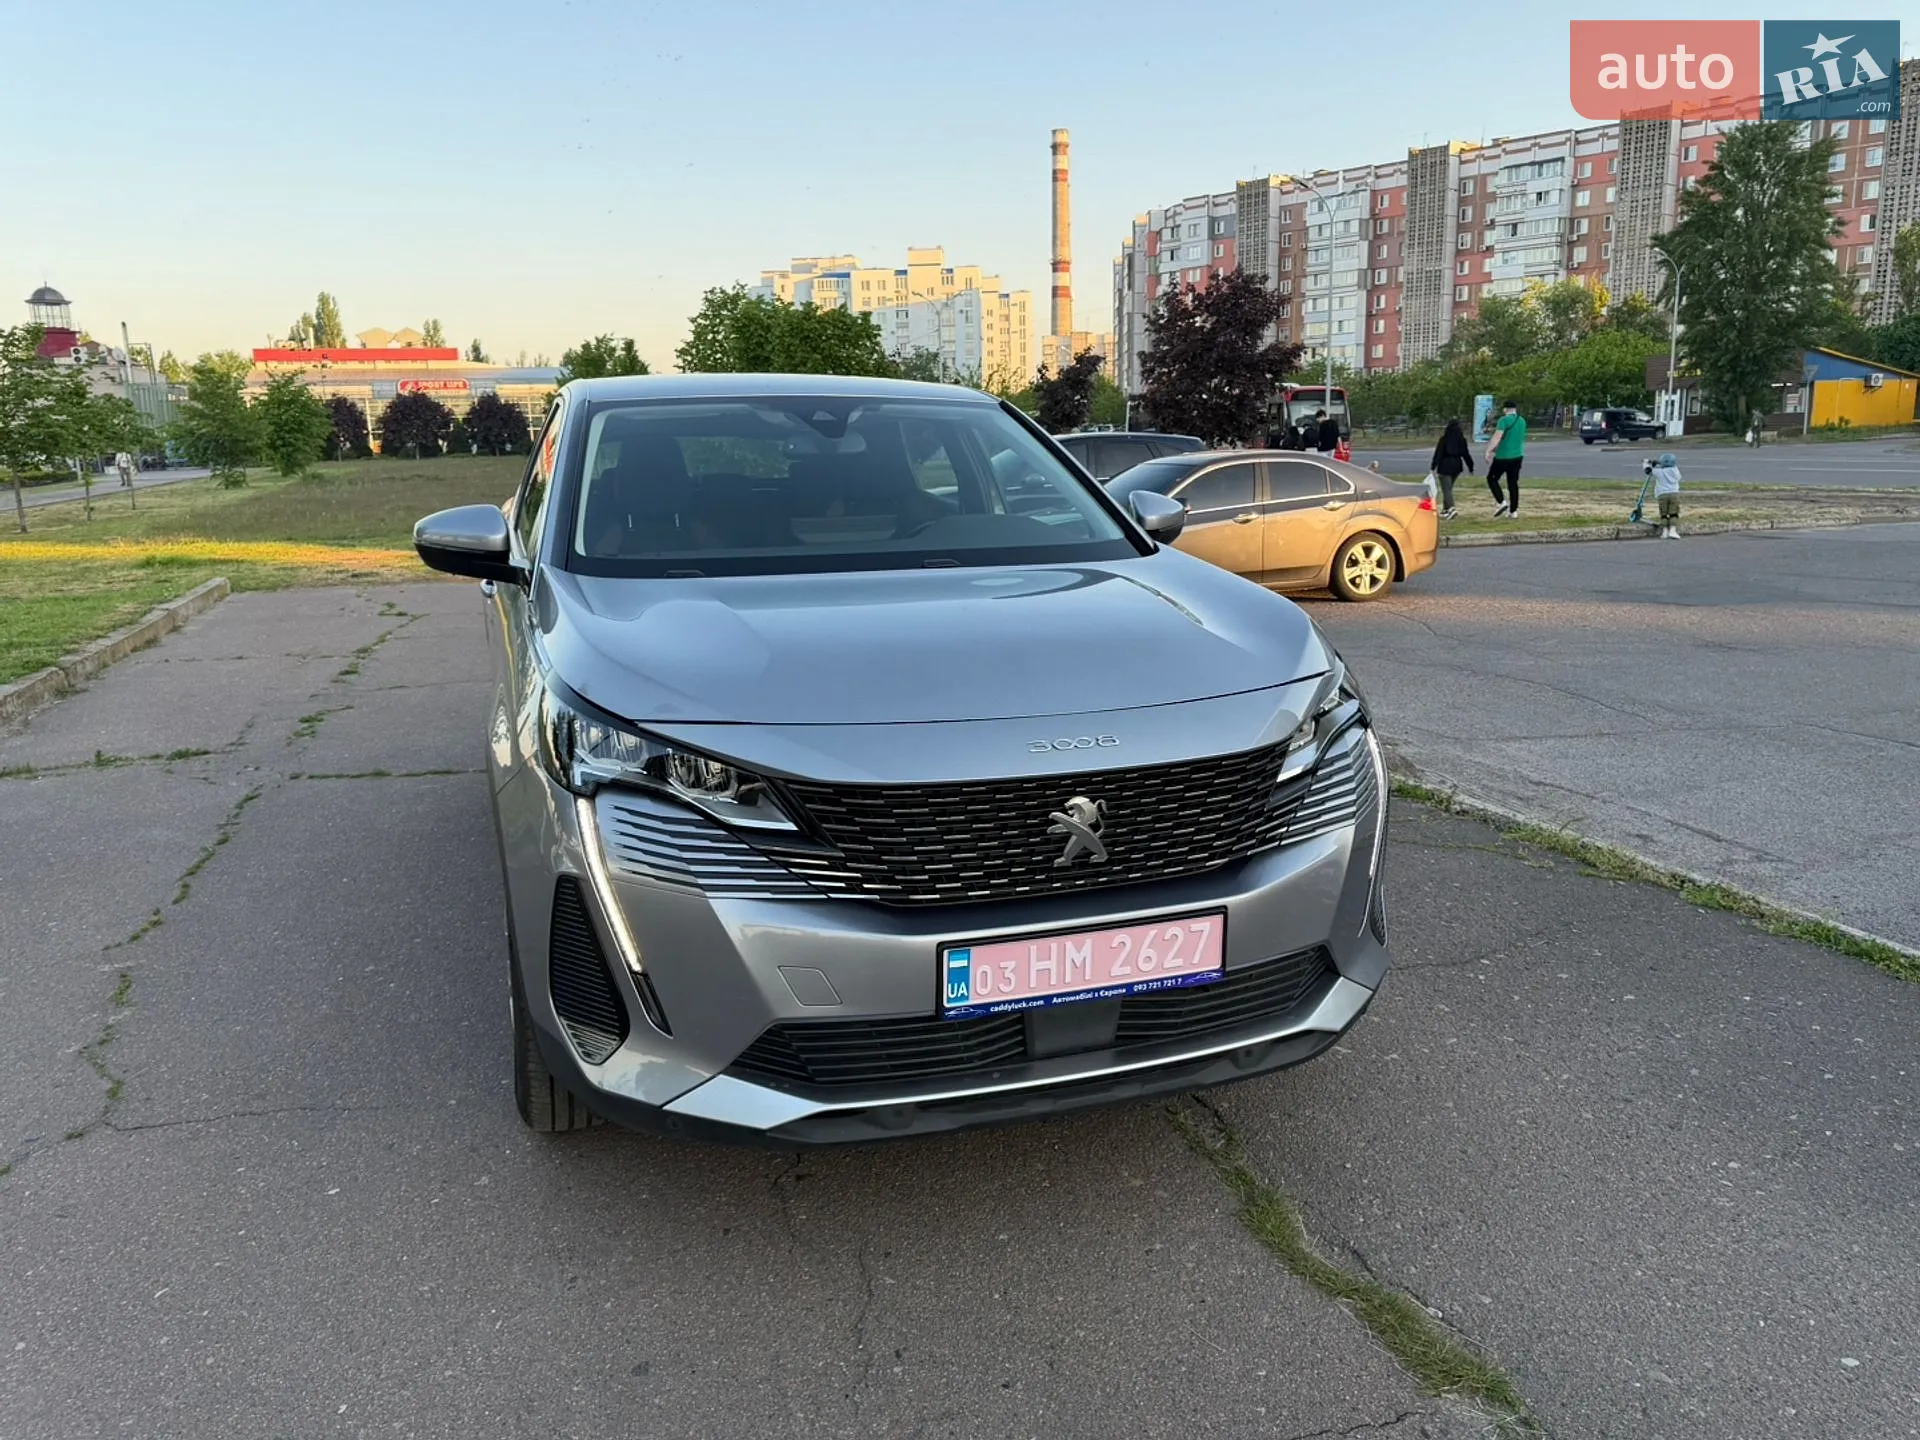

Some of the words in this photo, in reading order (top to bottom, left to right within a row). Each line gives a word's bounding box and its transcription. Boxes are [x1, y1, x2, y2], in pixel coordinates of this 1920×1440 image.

[1027, 735, 1120, 752] 3008
[975, 961, 1016, 996] 03
[1029, 939, 1092, 988] HM
[1110, 923, 1211, 977] 2627
[948, 981, 968, 998] UA
[990, 999, 1045, 1012] caddyluck.com
